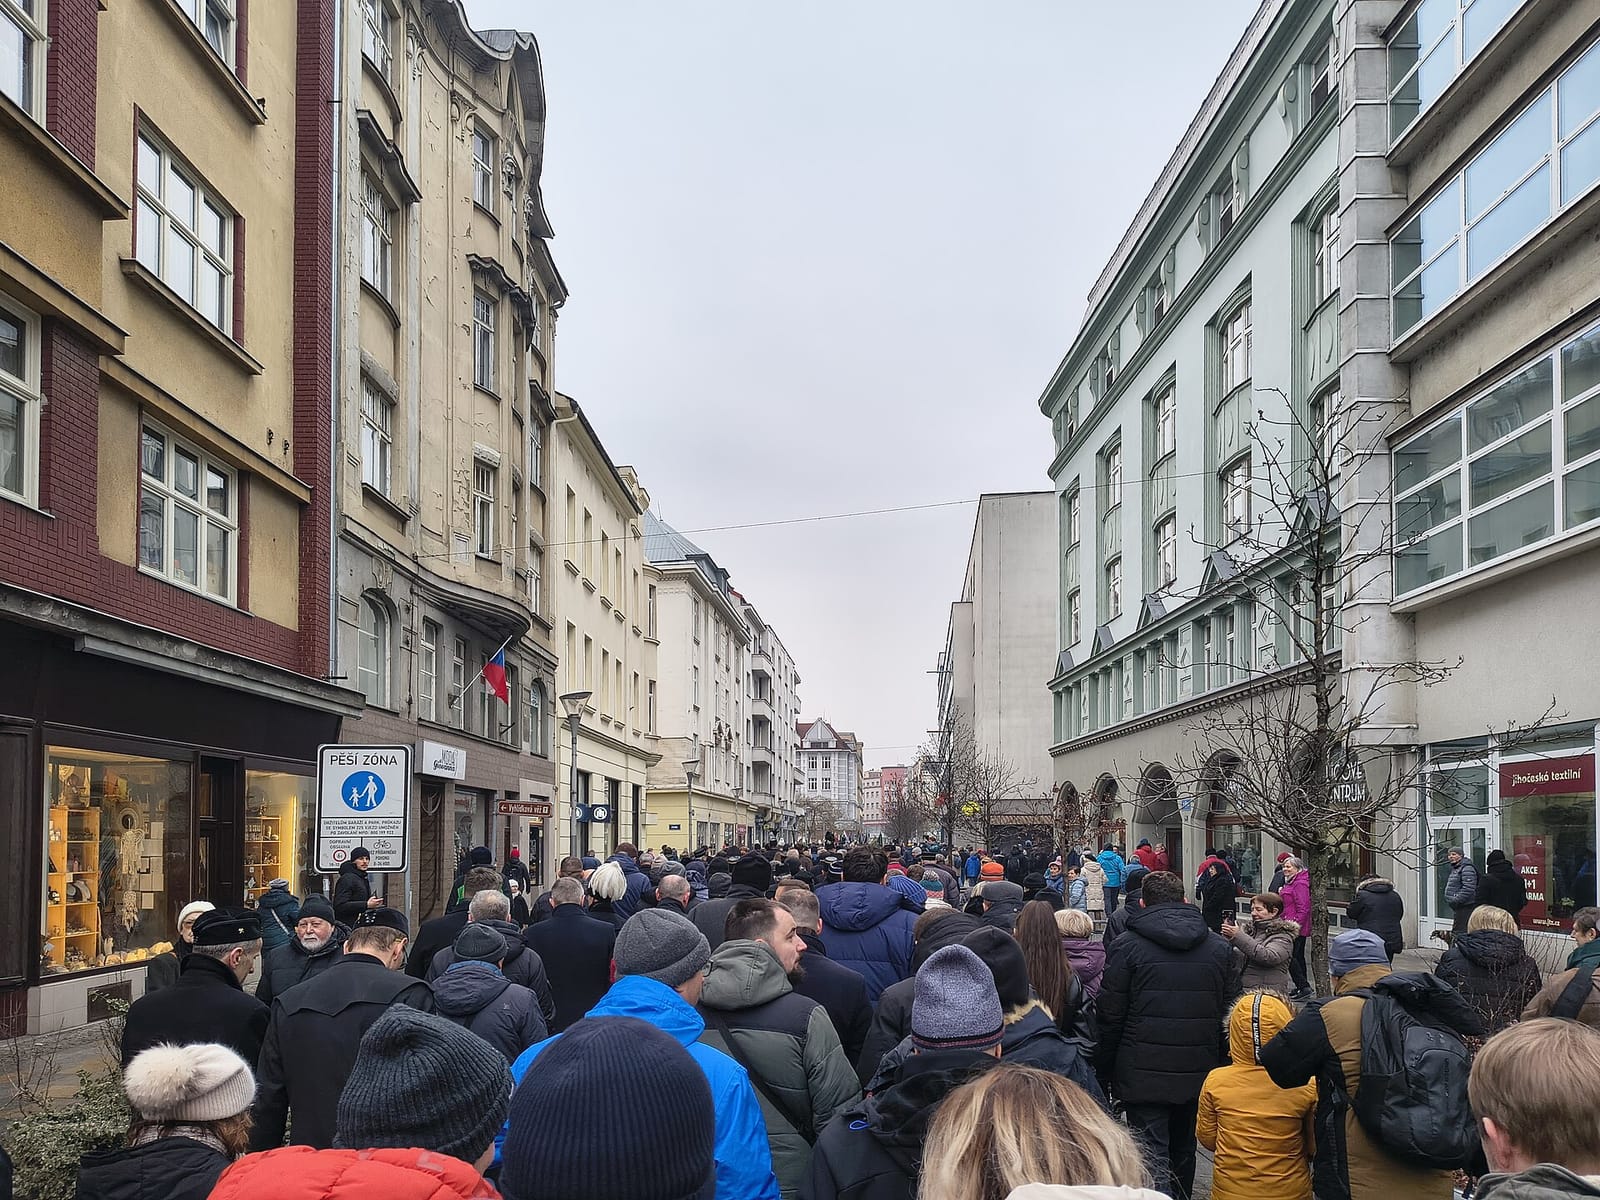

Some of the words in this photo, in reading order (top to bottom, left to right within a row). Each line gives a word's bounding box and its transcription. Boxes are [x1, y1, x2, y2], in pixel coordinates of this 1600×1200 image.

[330, 752, 358, 766] PĚŠÍ
[362, 752, 398, 766] ZÓNA
[1512, 771, 1549, 787] jihočeská
[1551, 768, 1581, 781] textilní
[508, 803, 533, 814] Vyhlídková
[534, 804, 542, 814] věž
[1520, 866, 1539, 875] AKCE
[1523, 879, 1536, 890] 1+1
